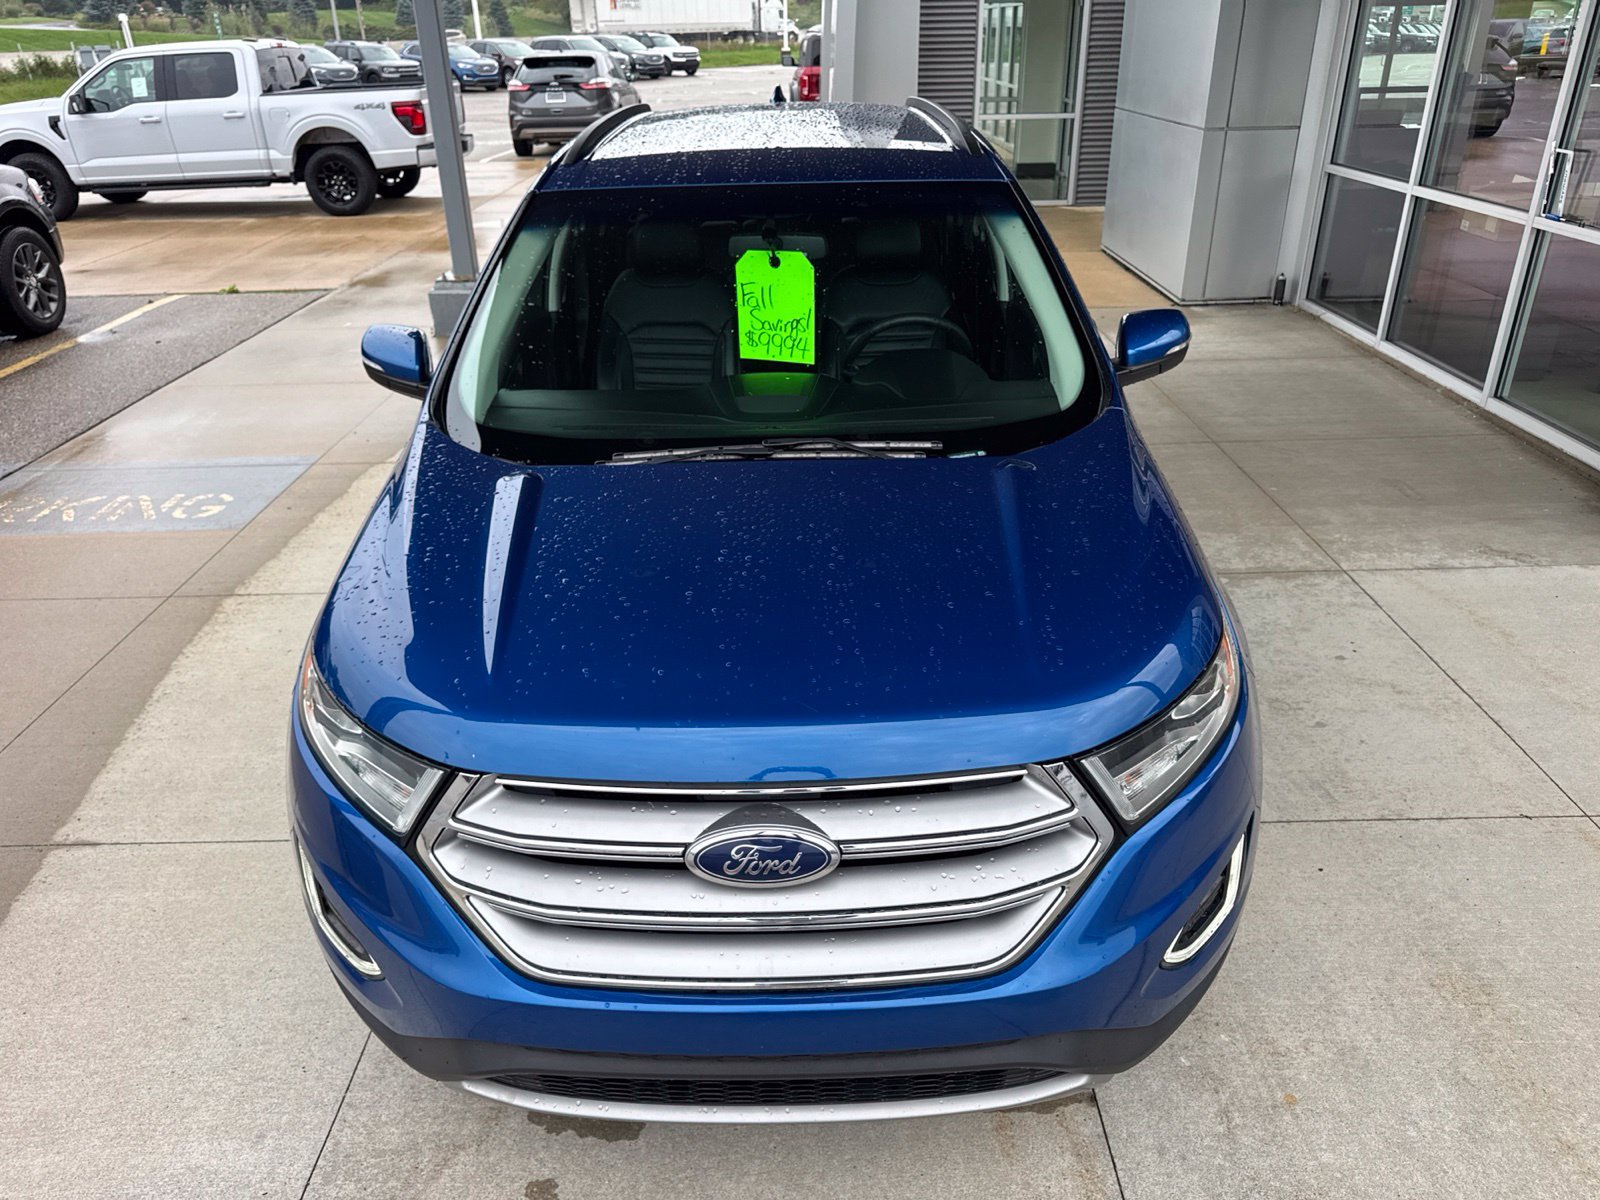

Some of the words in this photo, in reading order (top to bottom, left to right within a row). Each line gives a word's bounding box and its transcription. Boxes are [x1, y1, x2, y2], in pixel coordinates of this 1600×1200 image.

[740, 281, 774, 310] Fall
[744, 330, 810, 359] $9994
[722, 844, 803, 876] Ford
